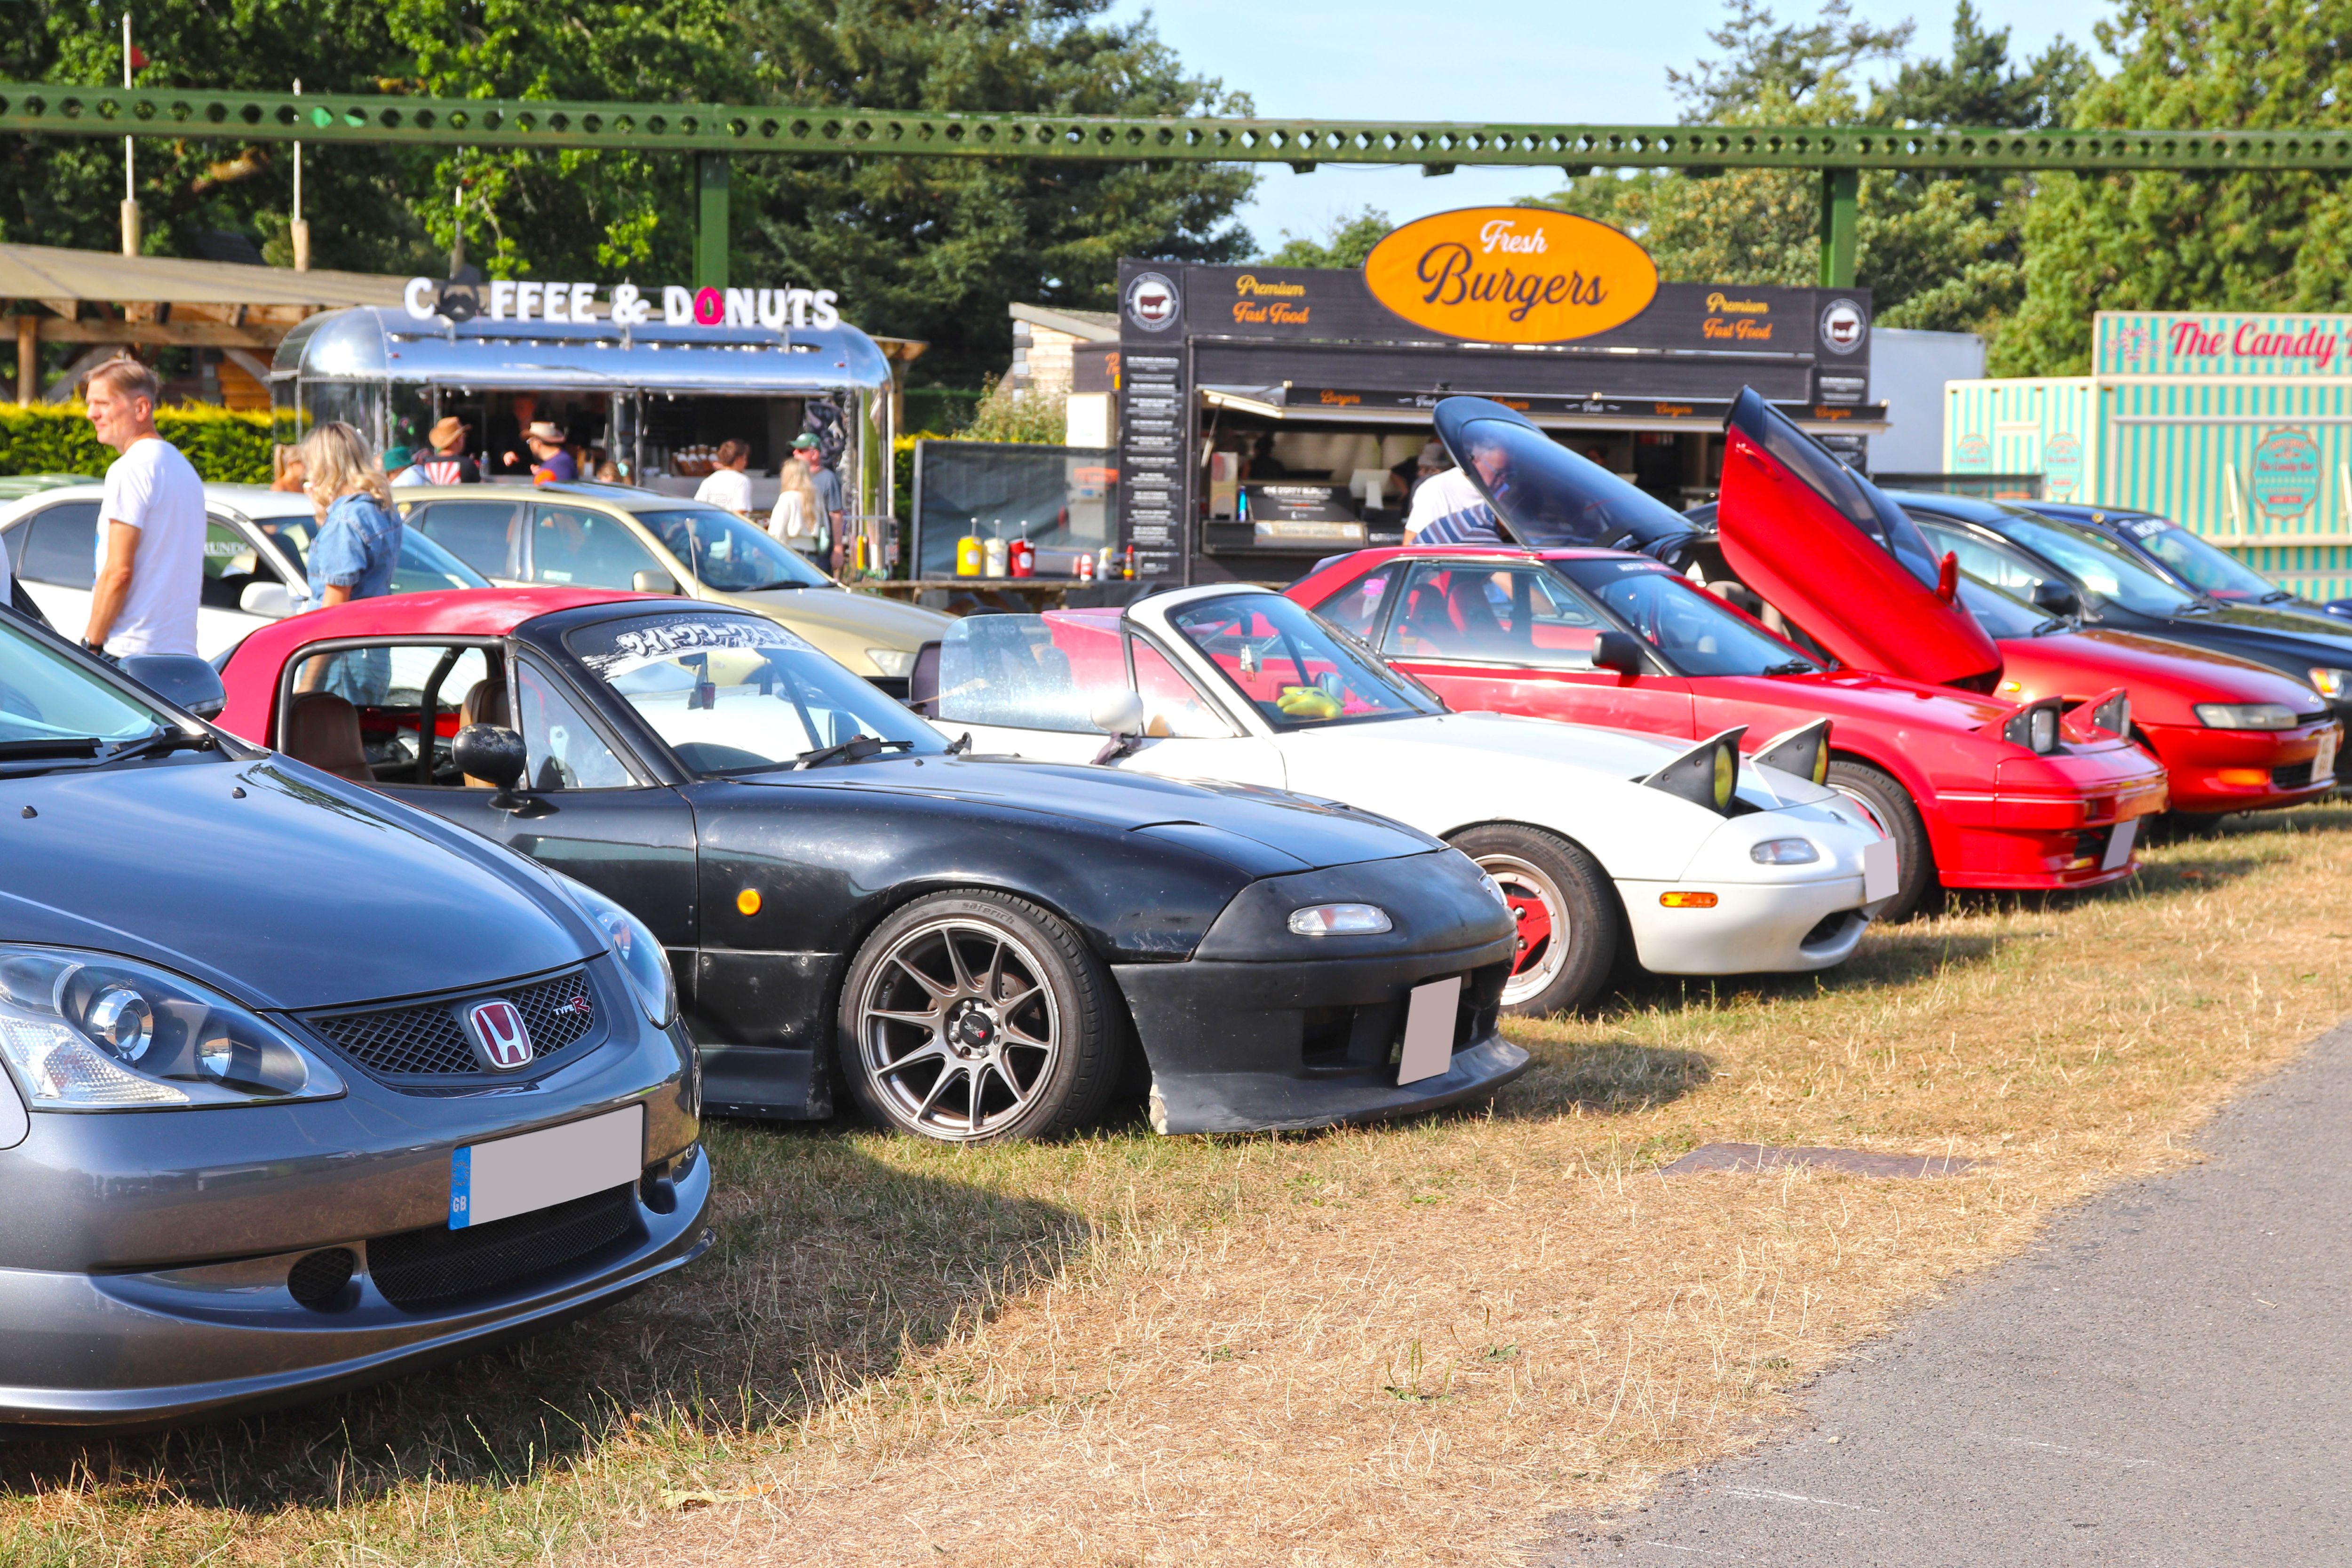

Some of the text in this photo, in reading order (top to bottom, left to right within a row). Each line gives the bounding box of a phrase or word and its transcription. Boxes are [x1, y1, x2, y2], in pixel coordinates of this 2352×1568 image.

[1480, 219, 1548, 254] Fresh
[1236, 274, 1306, 297] Premium
[1416, 241, 1609, 322] Burgers
[611, 283, 652, 325] &
[663, 285, 839, 330] DONUTS
[1232, 301, 1310, 325] Fast Food
[1706, 292, 1769, 314] Premium
[1702, 318, 1773, 340] Fast Food
[2169, 321, 2227, 356] The
[2233, 321, 2338, 368] Candy
[961, 902, 1015, 924] saferich
[553, 996, 590, 1016] TYPE R
[453, 1195, 467, 1212] GB
